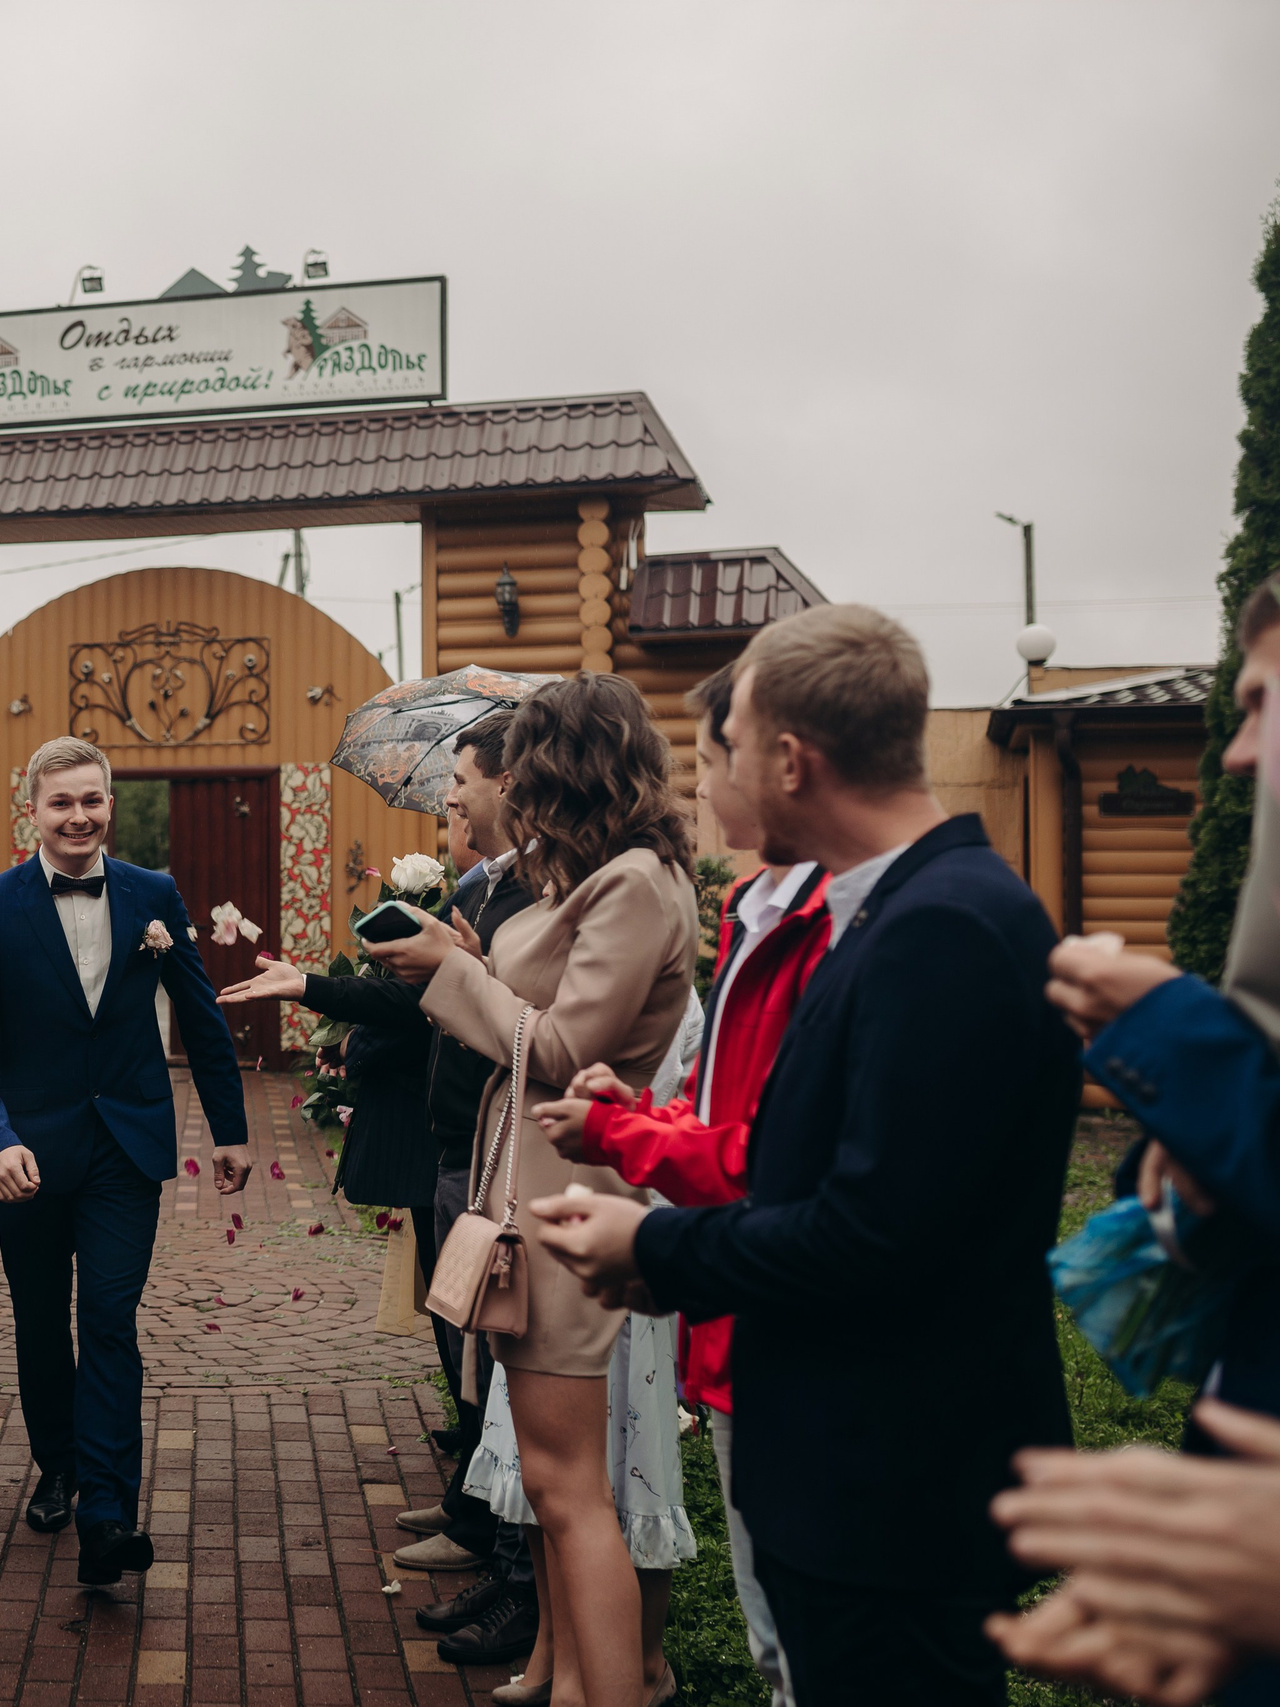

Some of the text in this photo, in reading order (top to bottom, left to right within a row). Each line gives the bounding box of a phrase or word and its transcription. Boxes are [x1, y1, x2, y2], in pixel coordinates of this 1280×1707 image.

[60, 318, 180, 351] Отдых
[89, 349, 233, 374] в гармонии
[97, 366, 274, 406] с природой!
